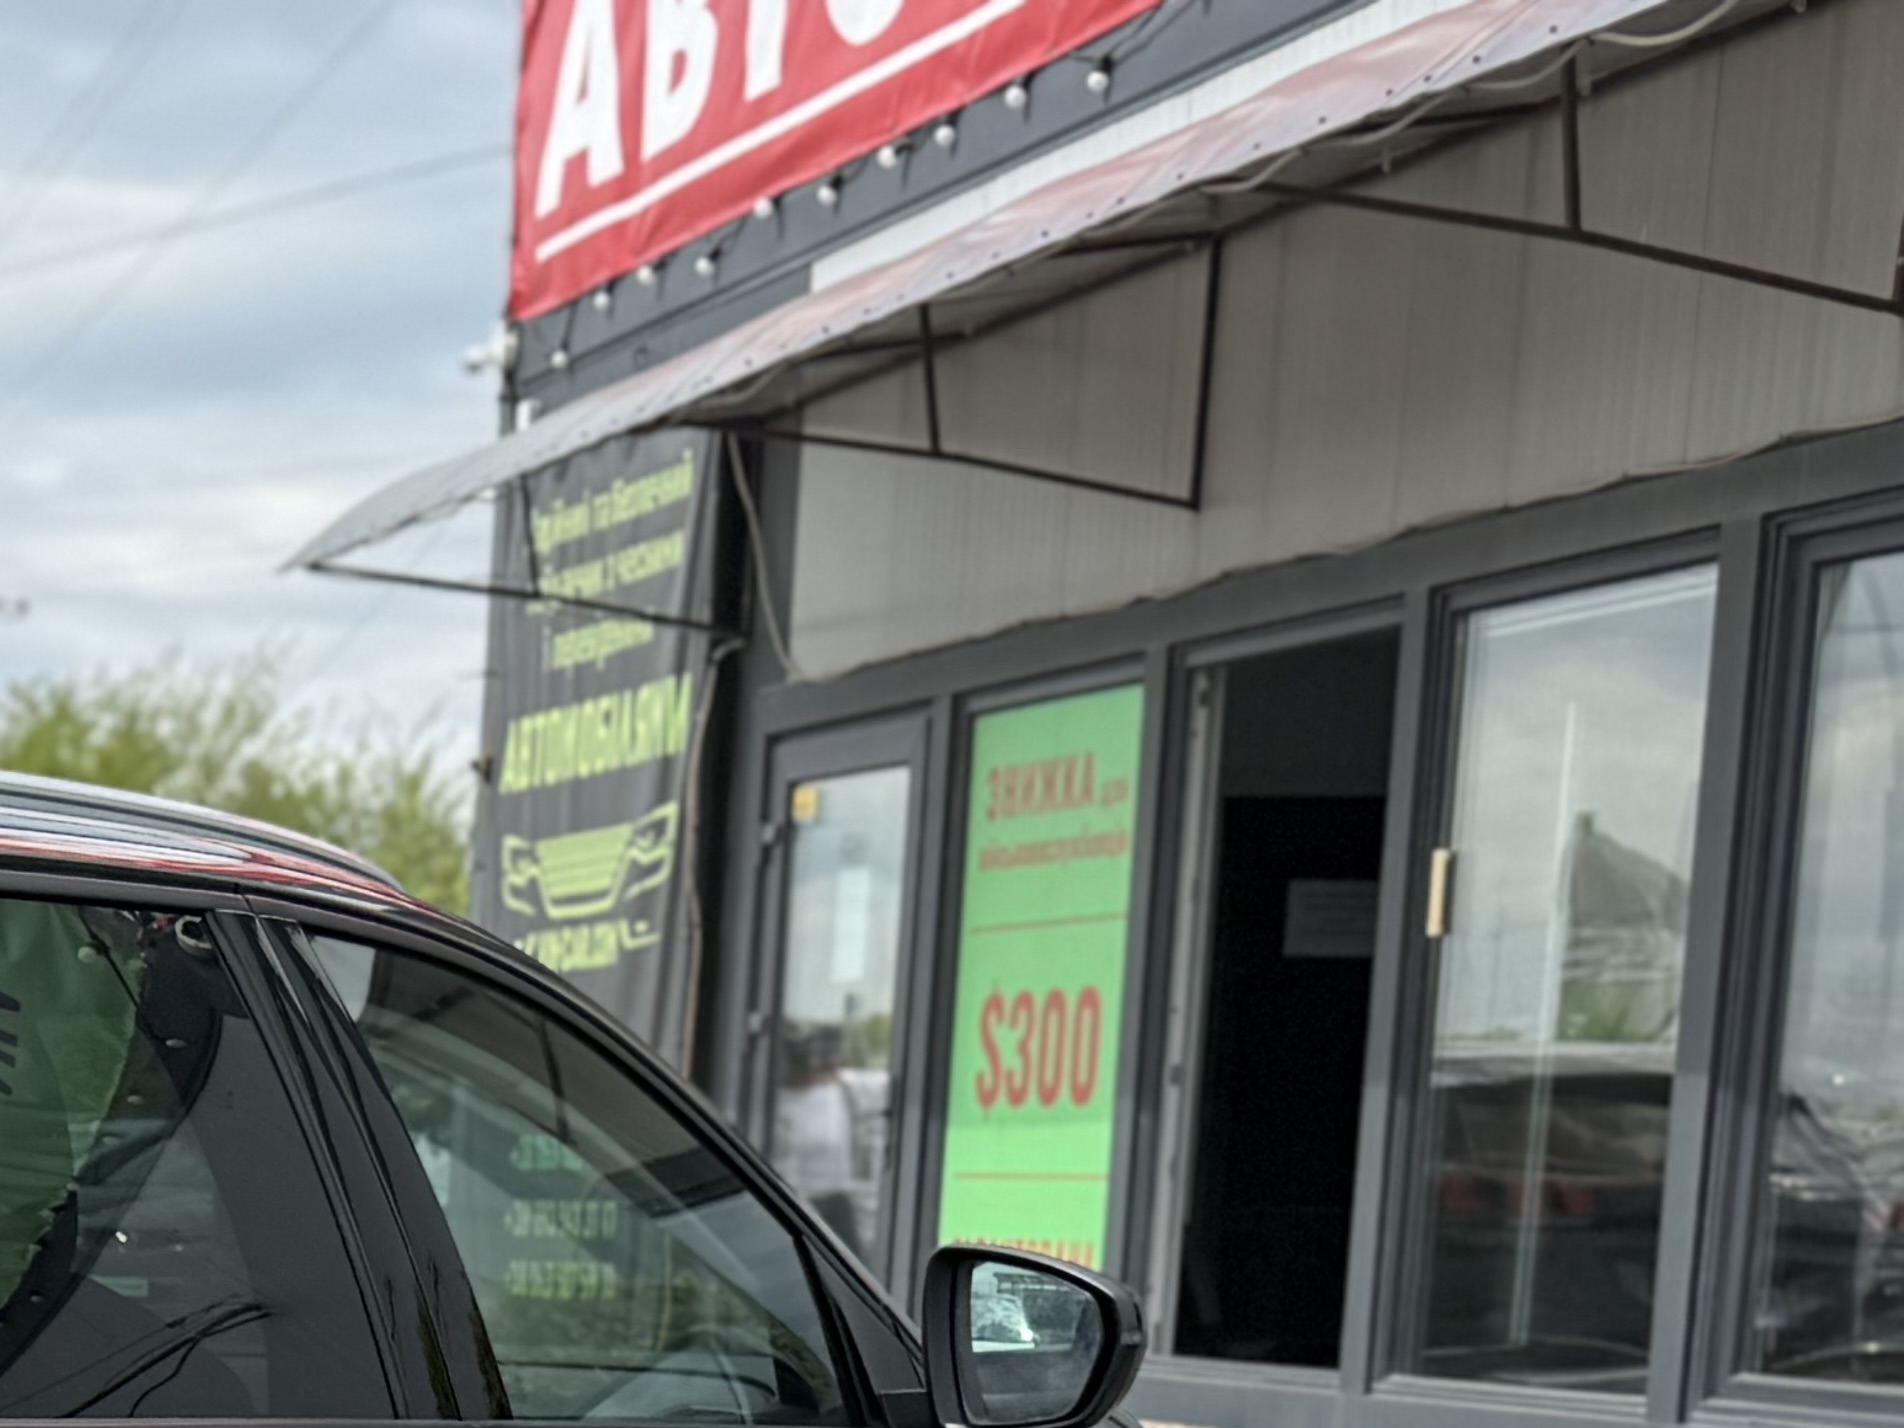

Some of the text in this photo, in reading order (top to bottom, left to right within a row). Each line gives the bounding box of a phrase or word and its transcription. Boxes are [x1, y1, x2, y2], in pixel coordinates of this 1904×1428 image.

[534, 0, 903, 219] АВ
[986, 752, 1095, 822] ЗНИЖКА
[975, 978, 1102, 1119] $300
